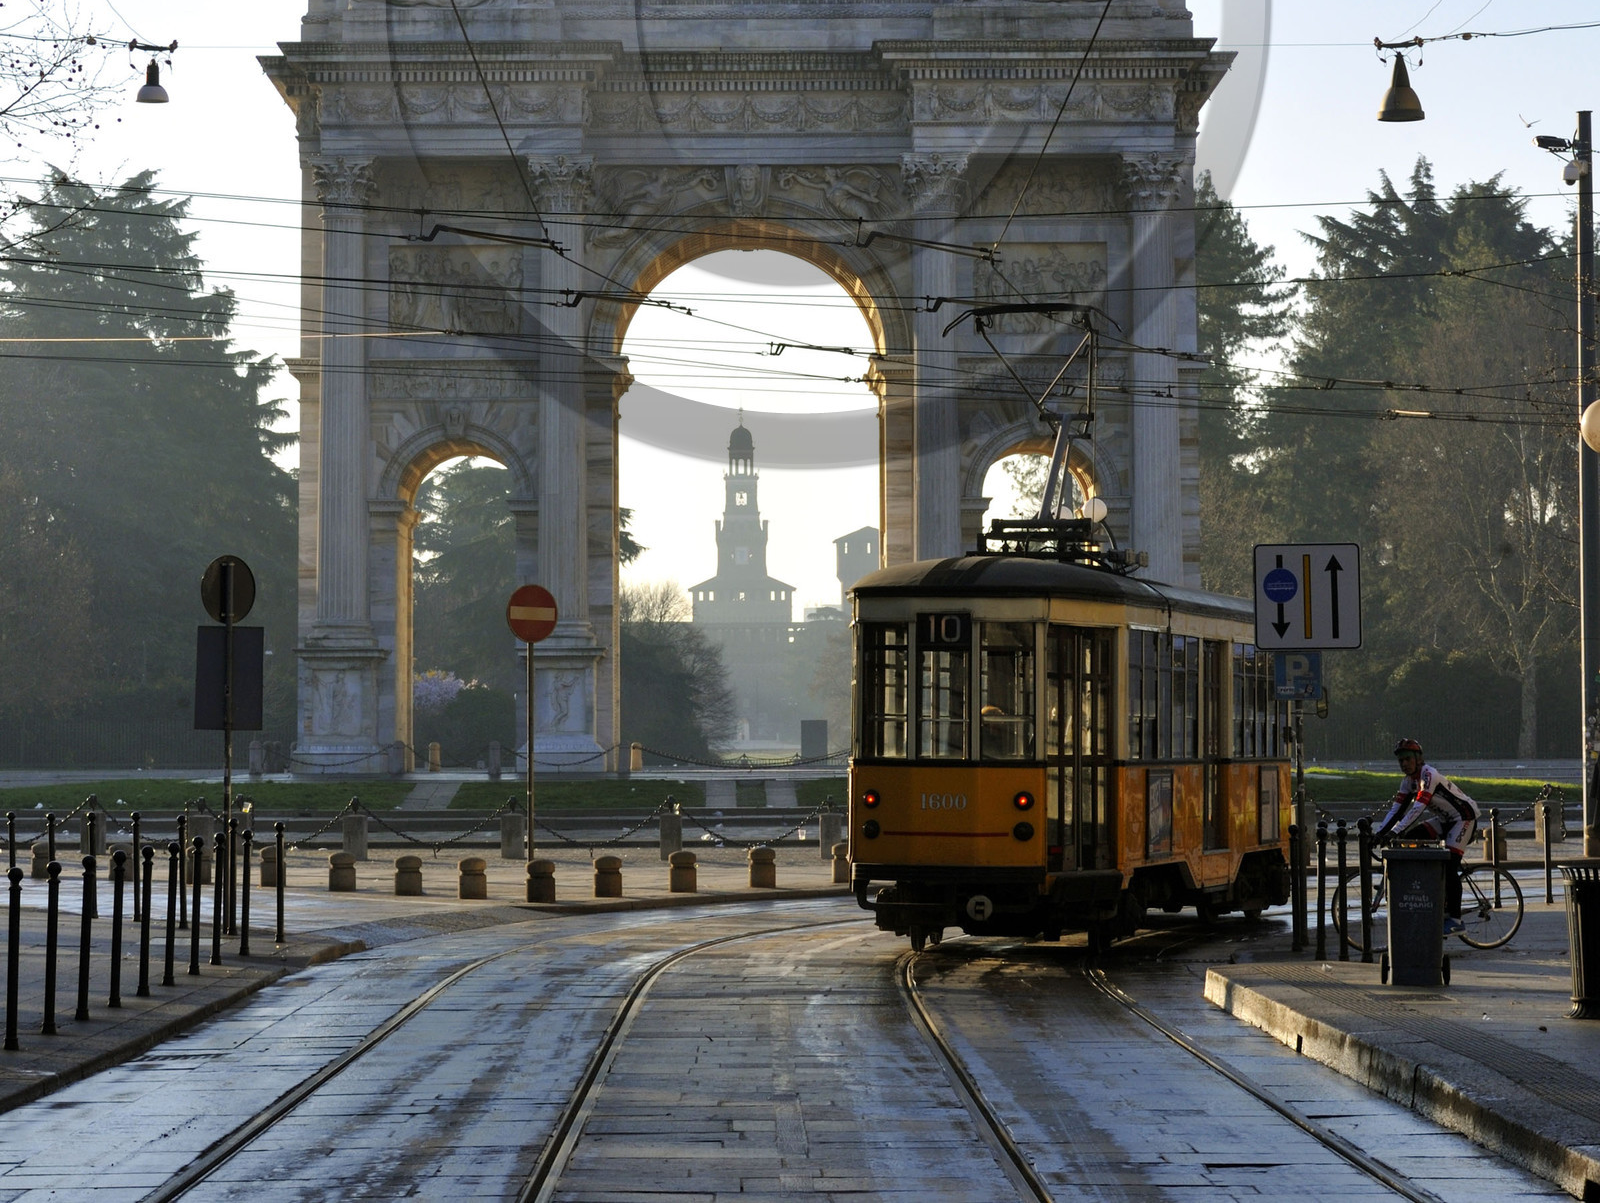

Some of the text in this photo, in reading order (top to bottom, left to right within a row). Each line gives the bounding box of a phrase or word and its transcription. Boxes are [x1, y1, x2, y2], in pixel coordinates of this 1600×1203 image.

[929, 614, 961, 643] 10
[1285, 654, 1310, 683] P
[920, 793, 967, 810] 1600
